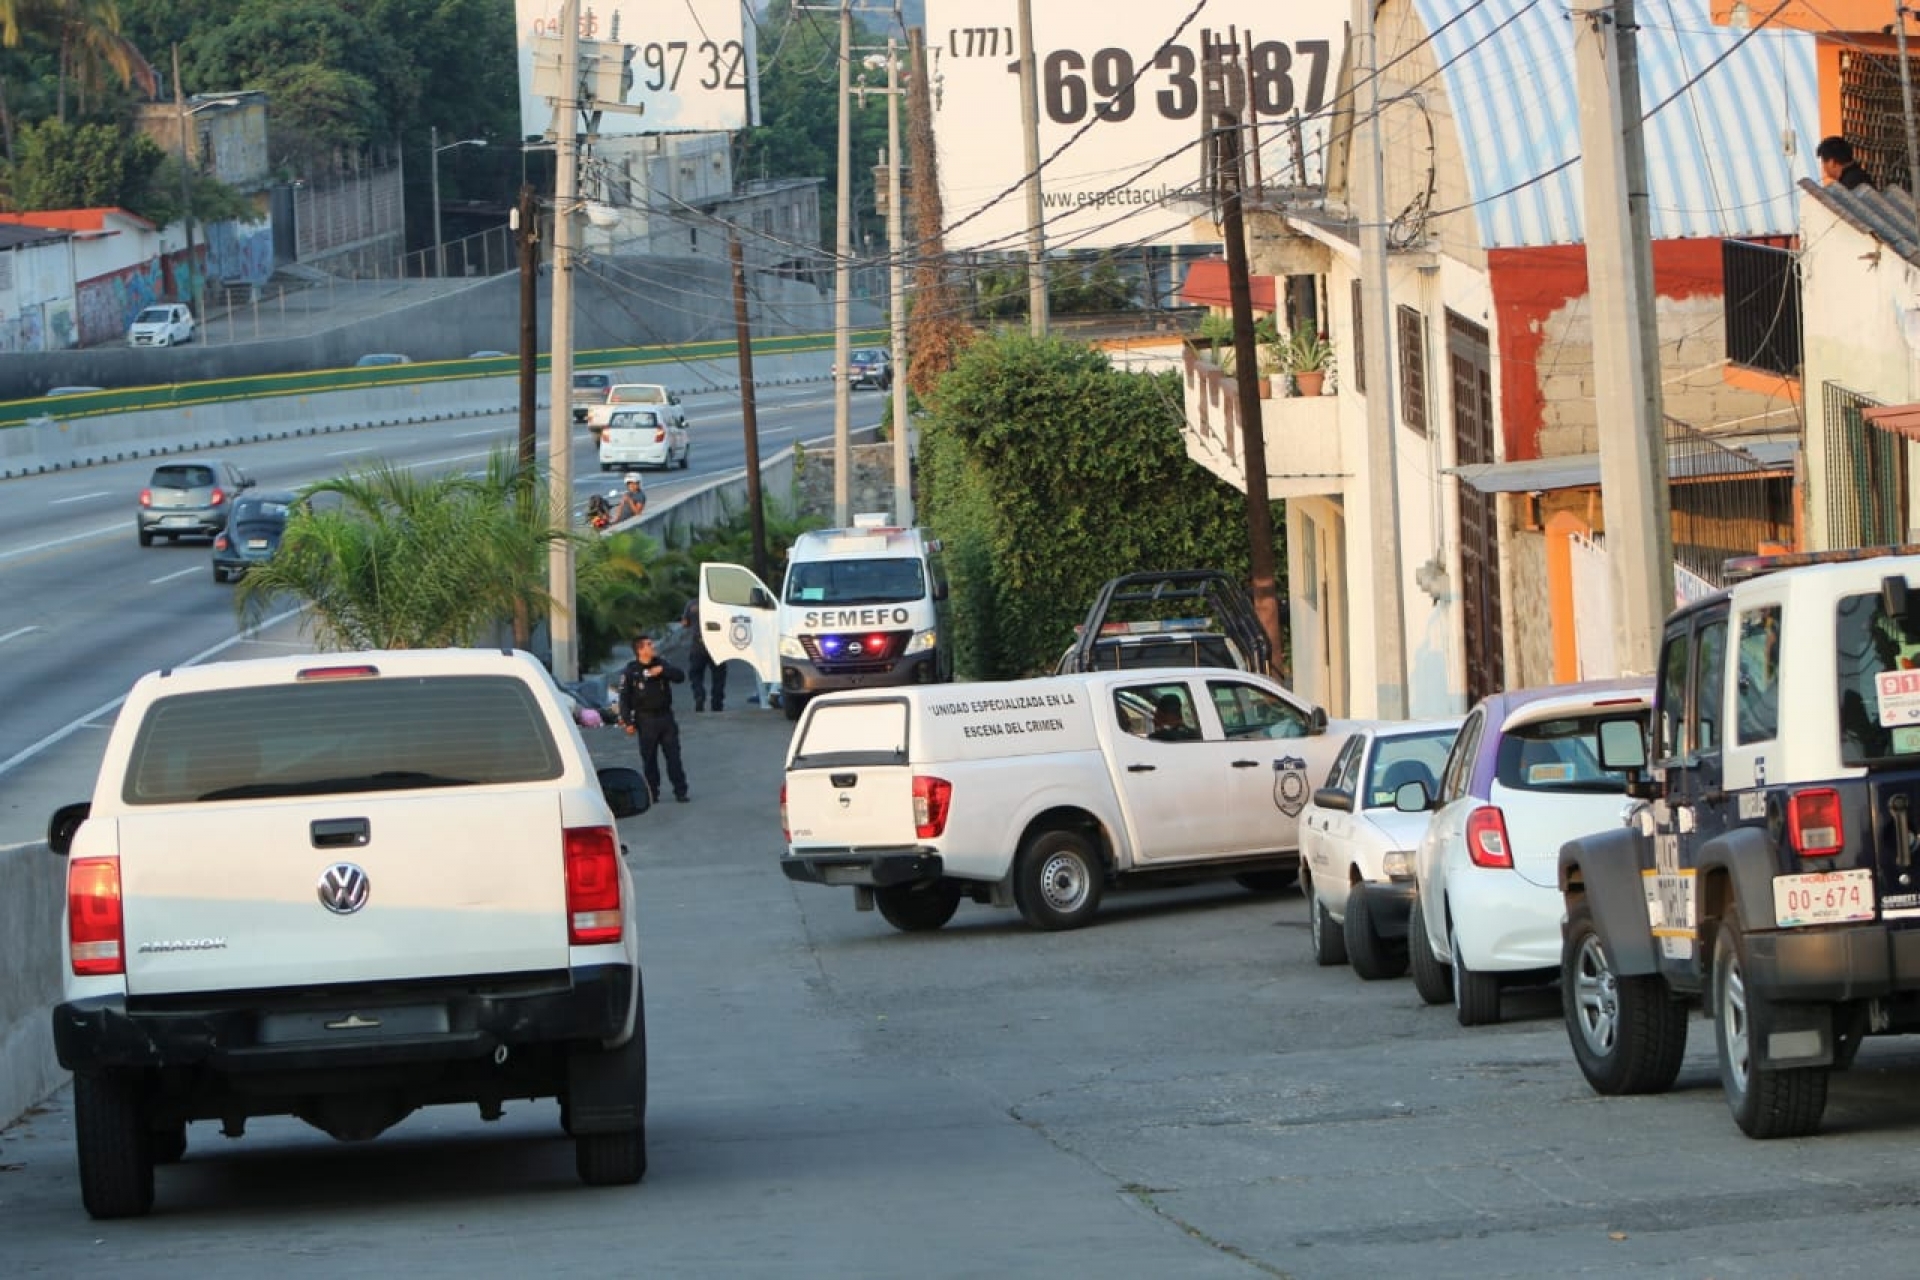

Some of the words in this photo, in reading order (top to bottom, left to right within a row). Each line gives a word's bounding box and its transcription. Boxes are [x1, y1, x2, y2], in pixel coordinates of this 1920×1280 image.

[949, 27, 1013, 57] (777)
[804, 607, 910, 628] SEMEFO
[971, 696, 1045, 713] ESPECIALIZADA
[1045, 694, 1060, 706] EN
[1060, 693, 1075, 705] LA
[963, 723, 1004, 738] ESCENA
[1005, 721, 1025, 734] DEL
[1026, 719, 1065, 733] CRIMEN
[1787, 886, 1860, 911] 00-674
[138, 936, 228, 954] AMAROK
